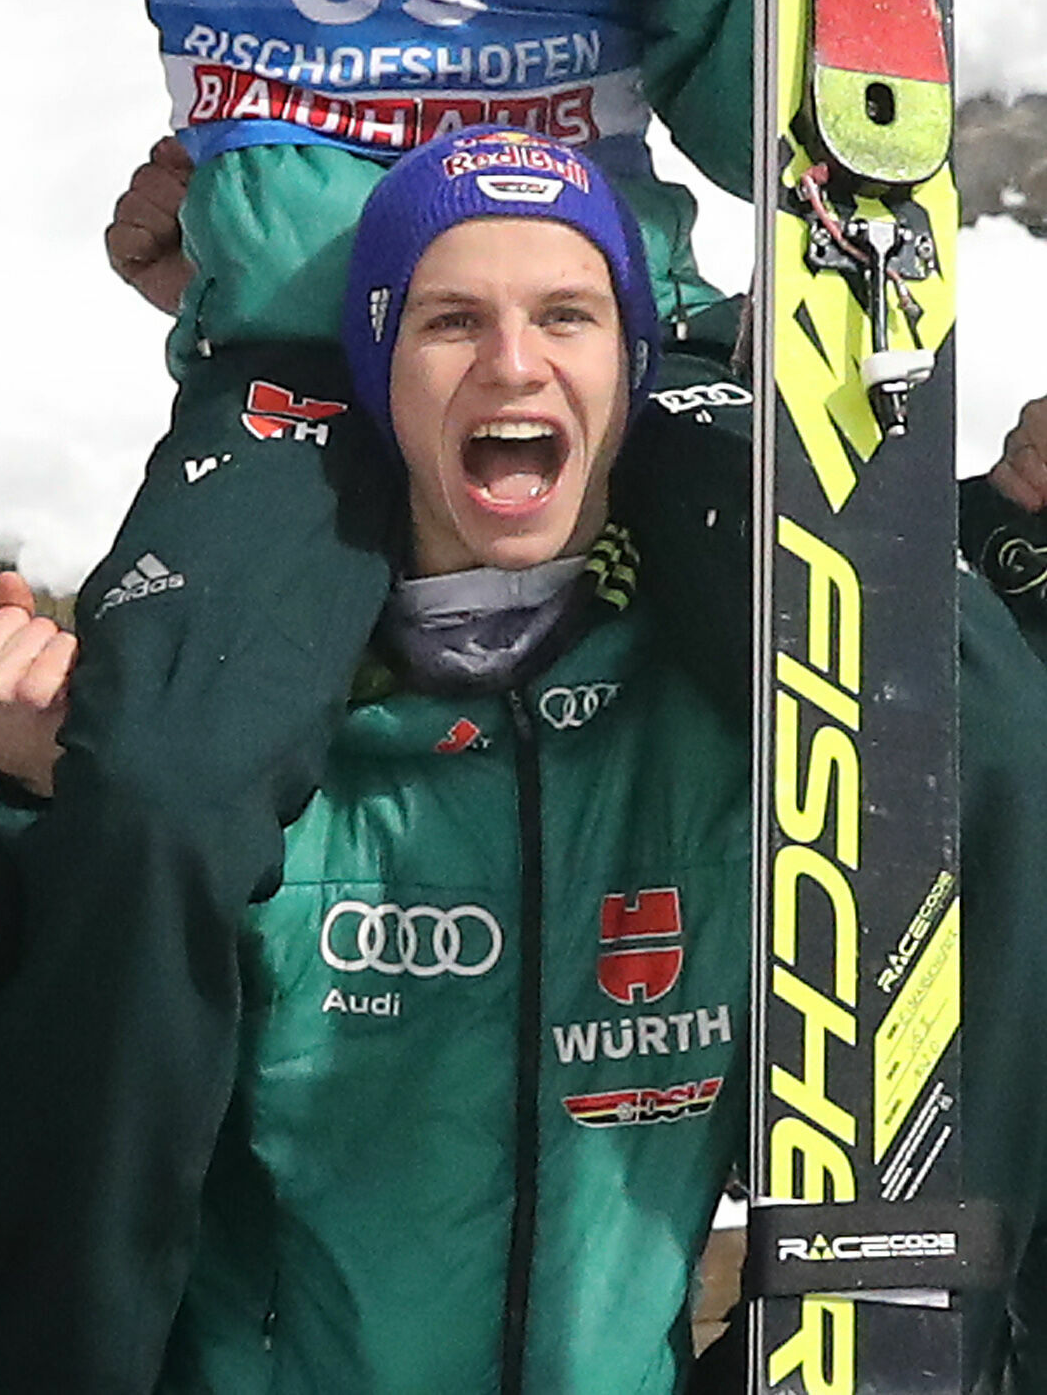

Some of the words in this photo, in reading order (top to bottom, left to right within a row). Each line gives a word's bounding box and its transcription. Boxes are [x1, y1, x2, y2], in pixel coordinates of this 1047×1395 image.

[183, 24, 603, 88] BISCHOFSHOFEN
[443, 146, 522, 179] Red
[520, 147, 590, 194] Bull
[322, 987, 401, 1017] Audi
[553, 1004, 732, 1064] WÜRTH
